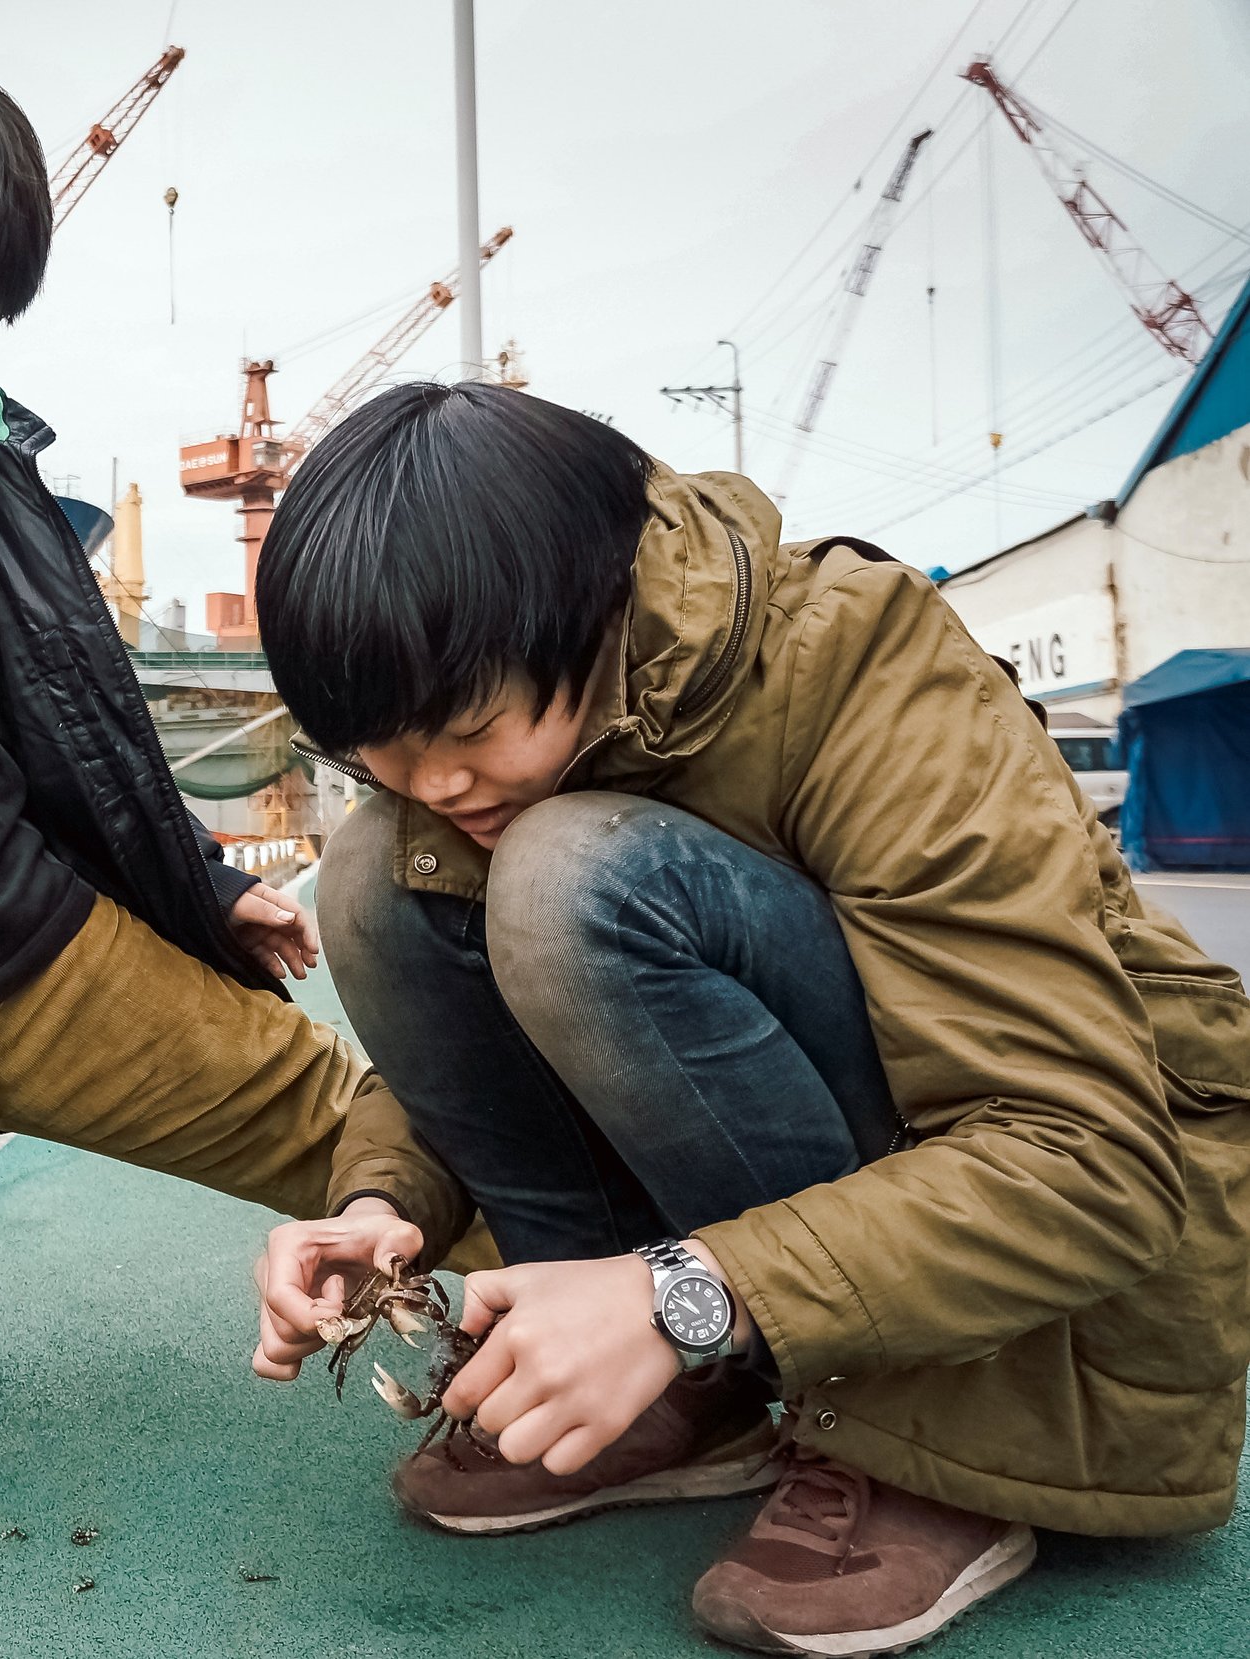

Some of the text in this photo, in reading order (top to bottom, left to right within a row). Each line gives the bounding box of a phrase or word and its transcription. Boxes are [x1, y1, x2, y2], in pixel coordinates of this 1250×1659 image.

[1010, 633, 1065, 684] ENG
[666, 1300, 676, 1310] 4
[712, 1309, 723, 1323] 10
[674, 1322, 686, 1333] 2
[696, 1328, 710, 1339] 12
